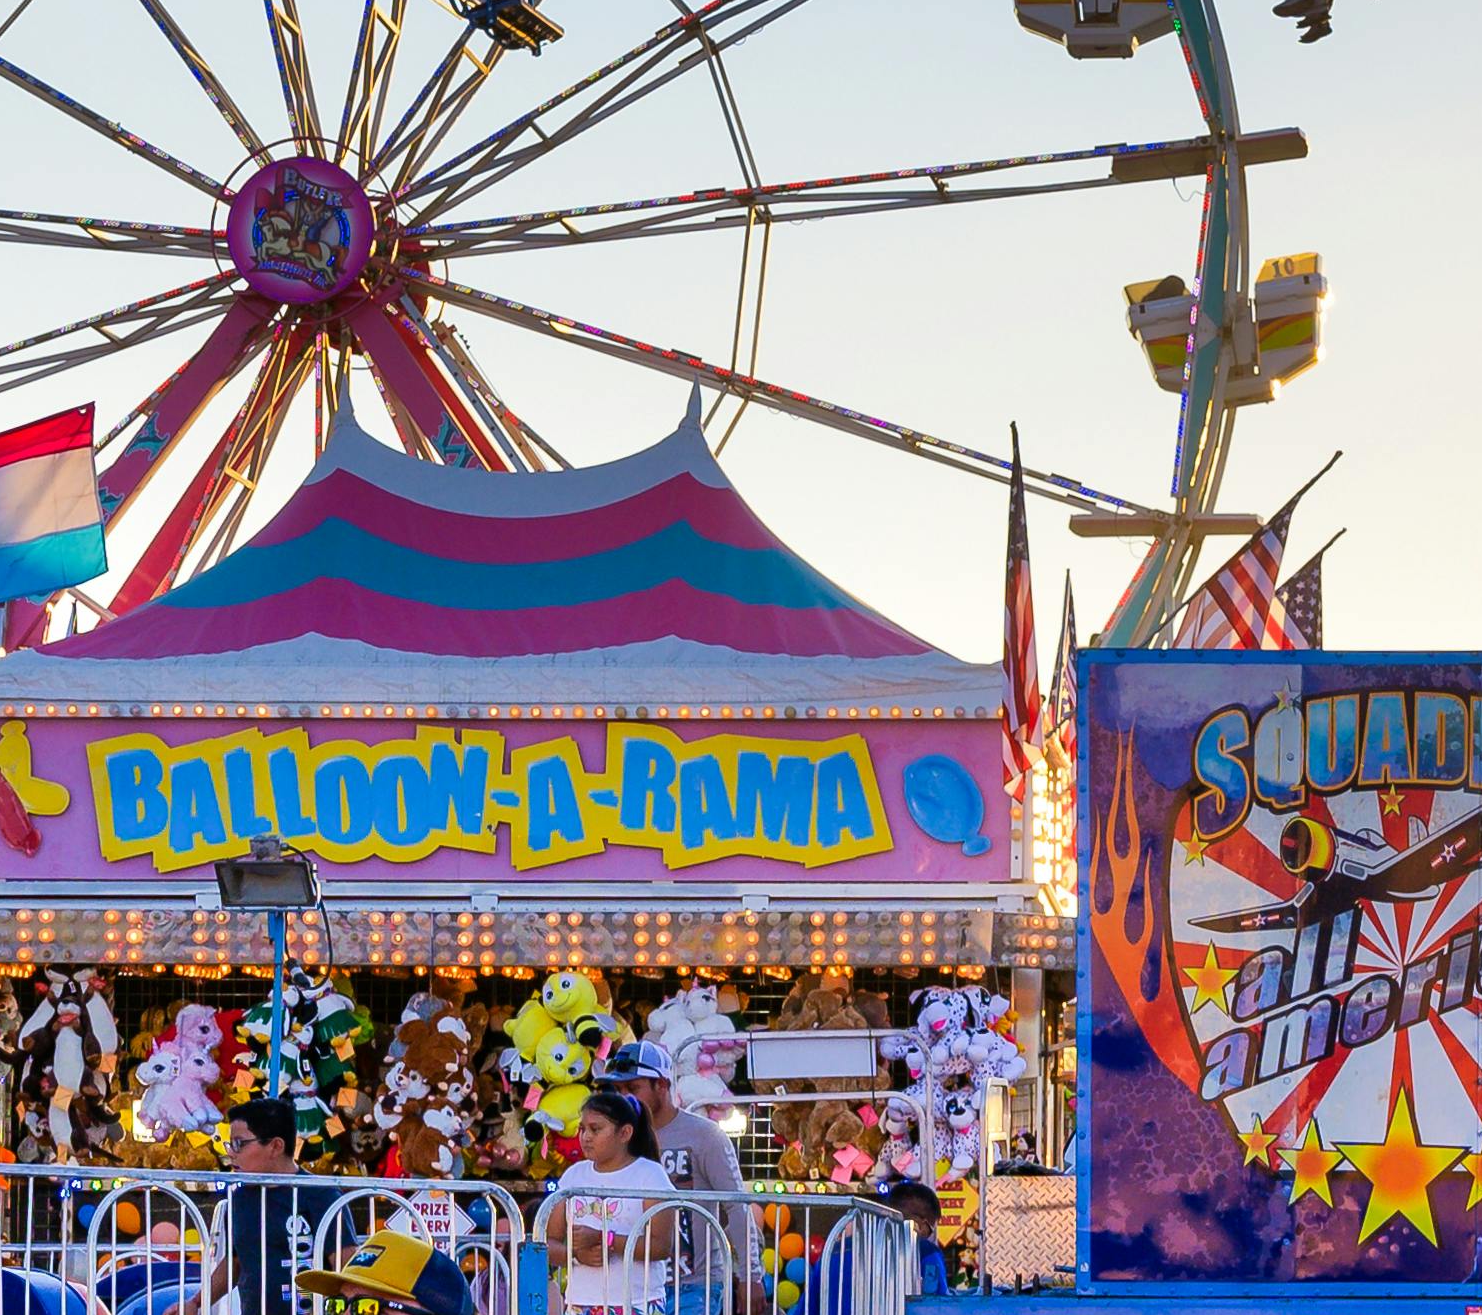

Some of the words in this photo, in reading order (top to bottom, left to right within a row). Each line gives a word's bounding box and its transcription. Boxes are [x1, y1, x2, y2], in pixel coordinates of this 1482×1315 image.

[1271, 258, 1295, 277] 10
[104, 736, 876, 854] BALLOON-A-RAMA
[1229, 903, 1363, 1026] all
[661, 1149, 689, 1175] GE
[413, 1202, 450, 1216] PRIZE
[527, 1292, 544, 1313] 12
